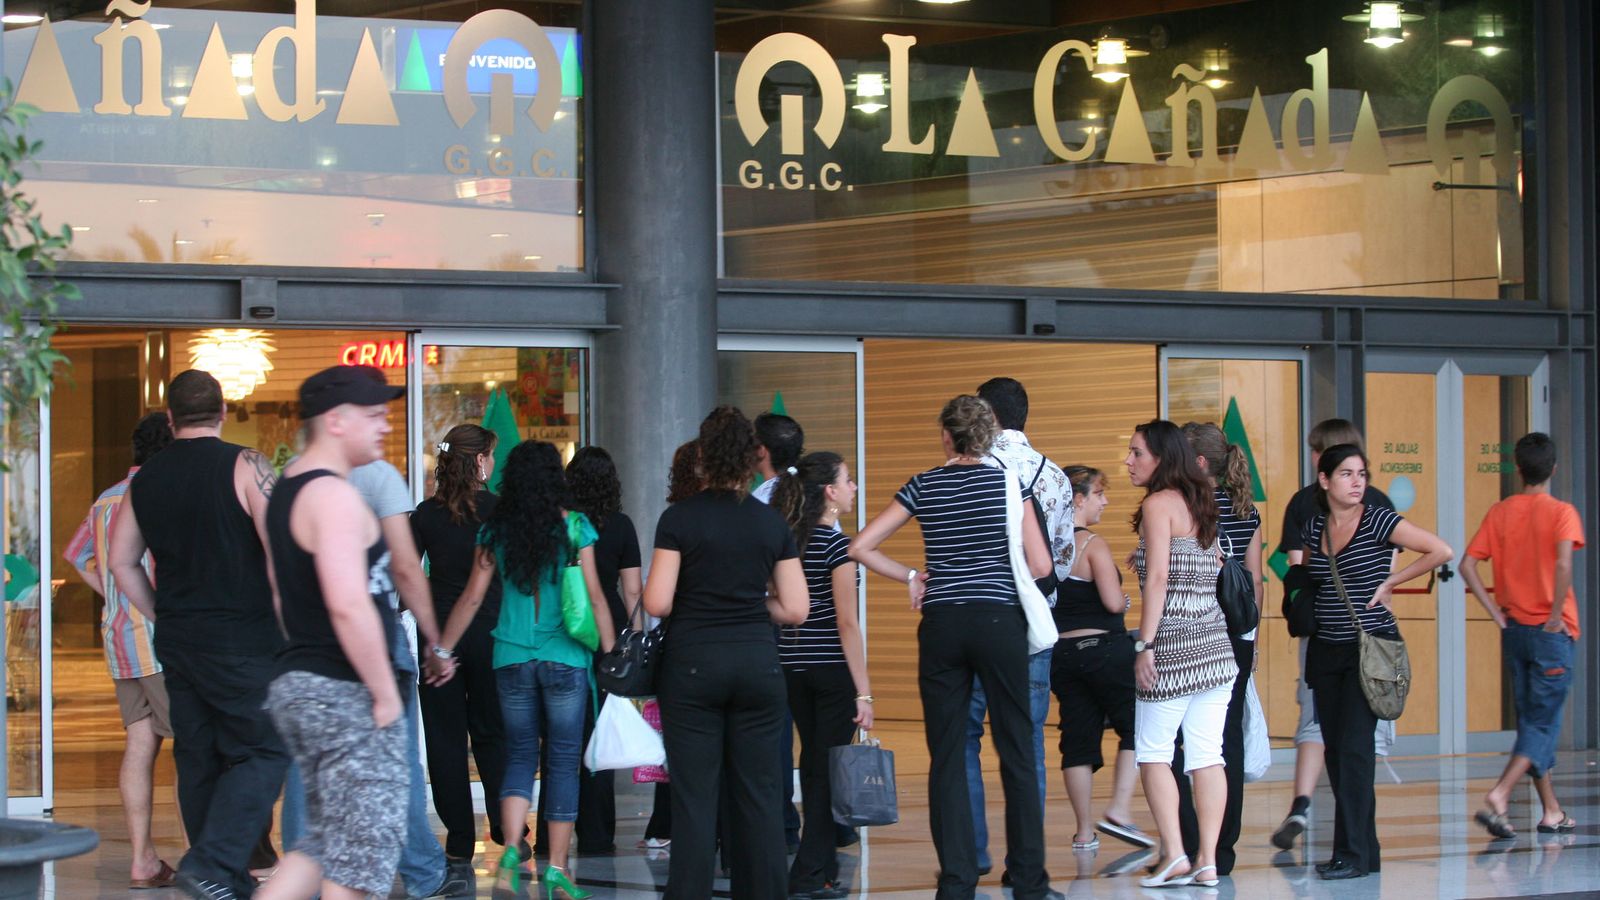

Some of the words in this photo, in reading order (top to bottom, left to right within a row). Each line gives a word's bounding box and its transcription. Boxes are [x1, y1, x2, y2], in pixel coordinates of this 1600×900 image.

[439, 54, 536, 69] BNVENIDO
[444, 144, 569, 177] G.G.C.
[739, 160, 853, 191] G.G.C.
